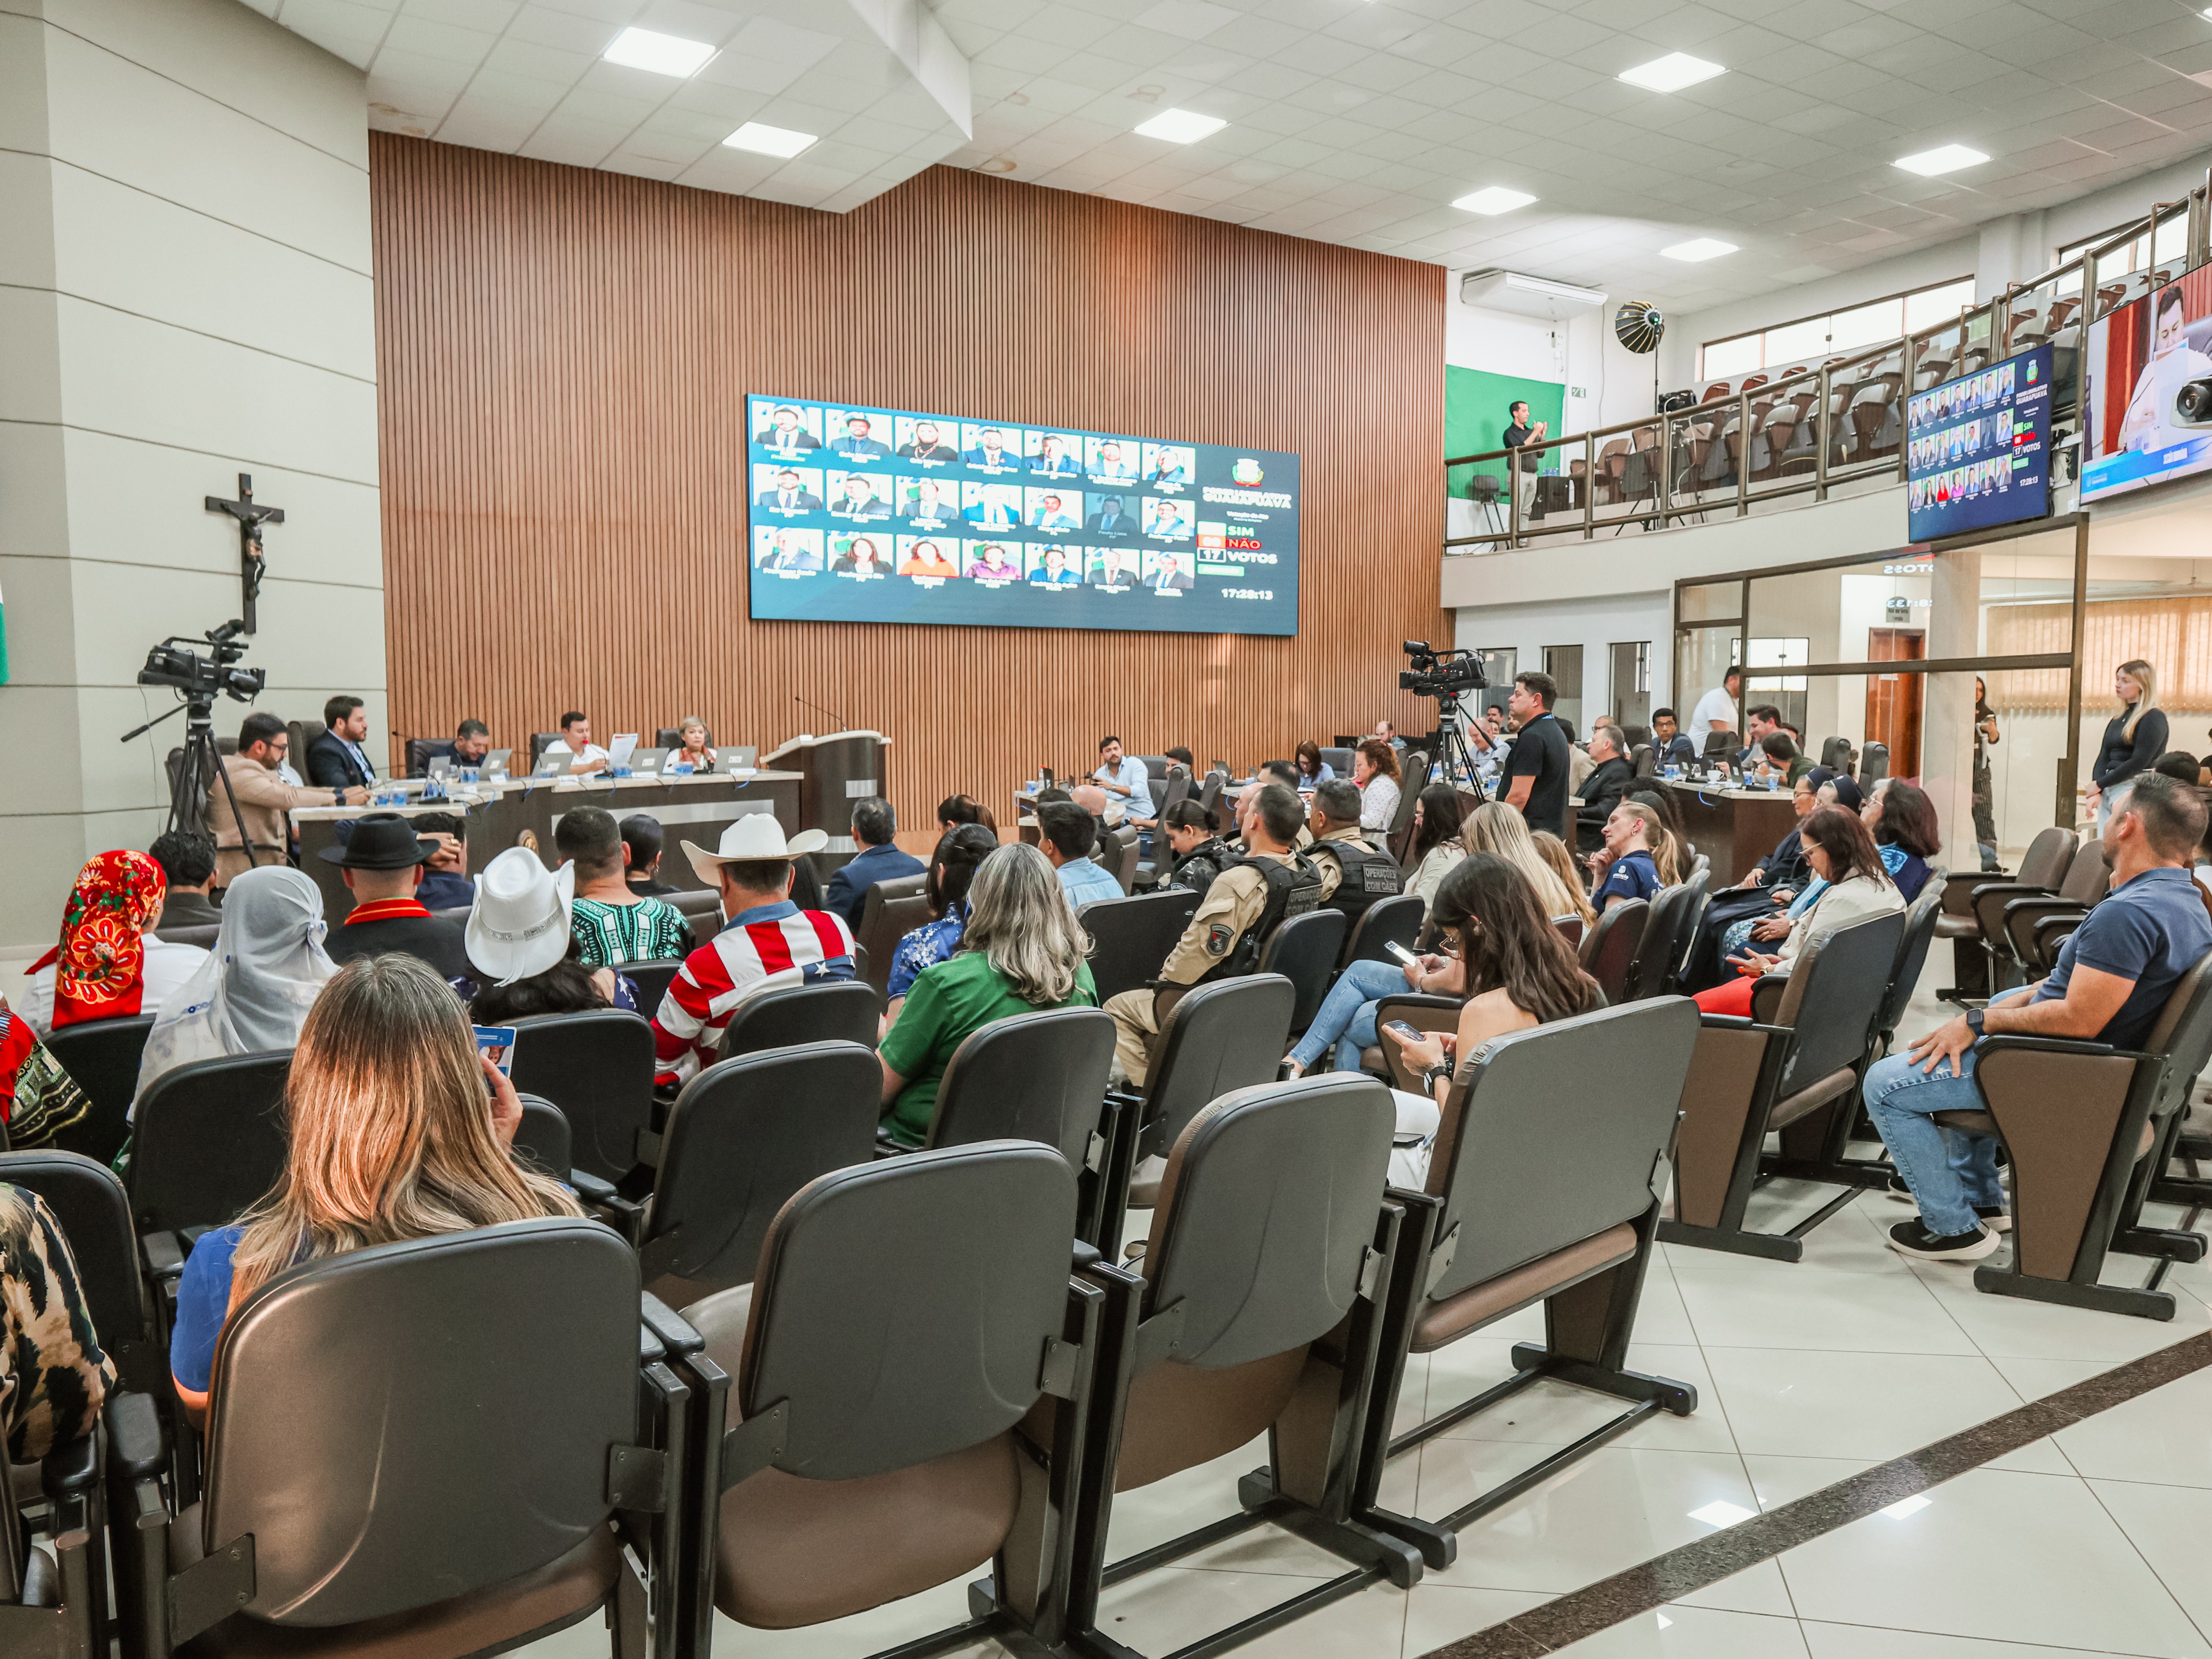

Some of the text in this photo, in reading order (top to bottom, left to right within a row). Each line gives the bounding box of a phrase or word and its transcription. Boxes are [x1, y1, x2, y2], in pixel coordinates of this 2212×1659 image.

[2023, 442, 2041, 454] VOTOS
[1202, 493, 1292, 508] GUARAPUAVA
[1228, 526, 1254, 537] SIM
[1228, 538, 1261, 550] NÃO
[1203, 550, 1278, 565] 17 VOTOS
[1221, 588, 1273, 601] 17:28:13
